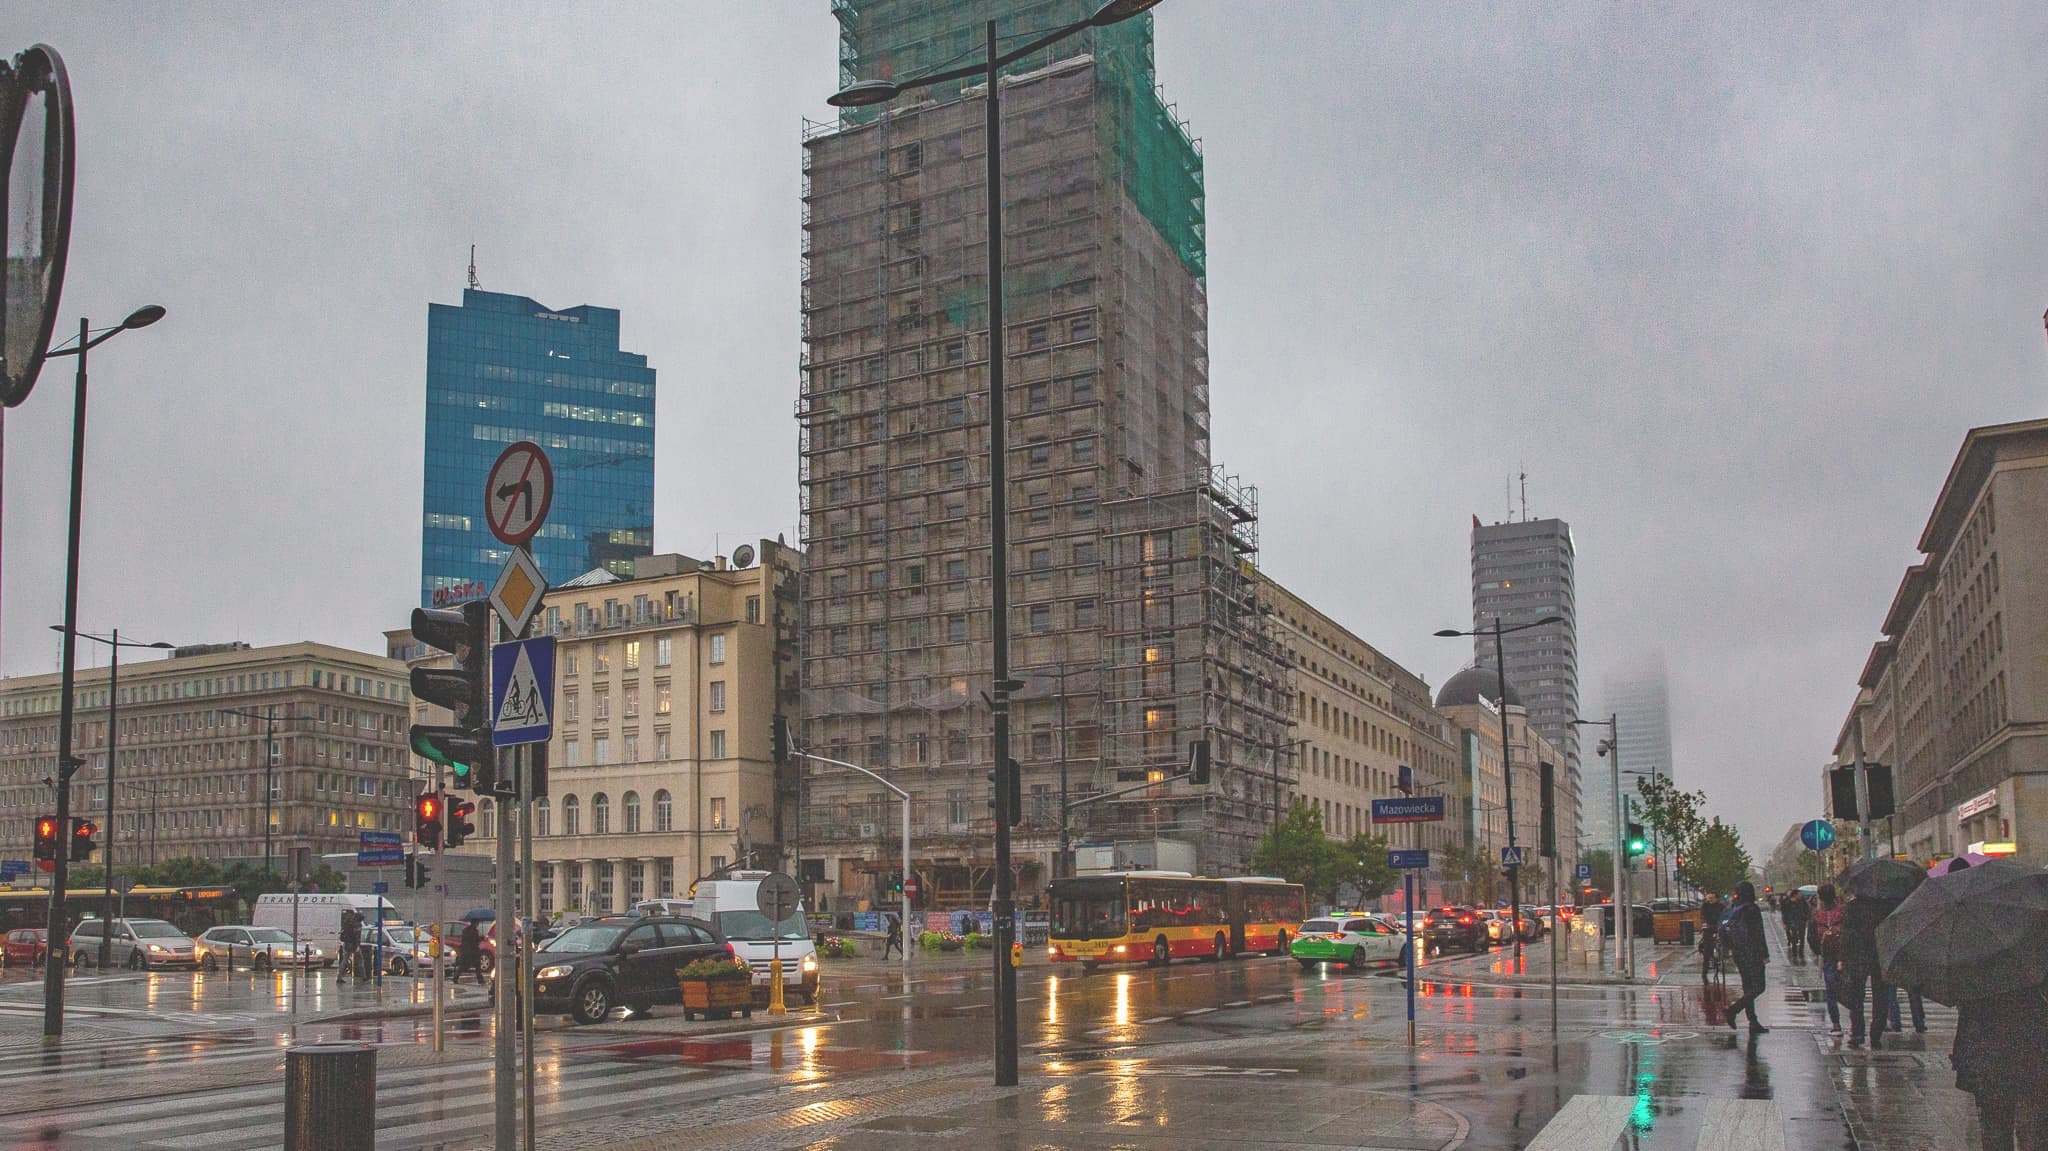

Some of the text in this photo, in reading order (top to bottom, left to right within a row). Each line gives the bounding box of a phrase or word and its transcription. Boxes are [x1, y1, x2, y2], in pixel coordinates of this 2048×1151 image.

[1379, 803, 1436, 815] Mazowiecka
[1393, 855, 1400, 864] P
[1579, 865, 1588, 877] P
